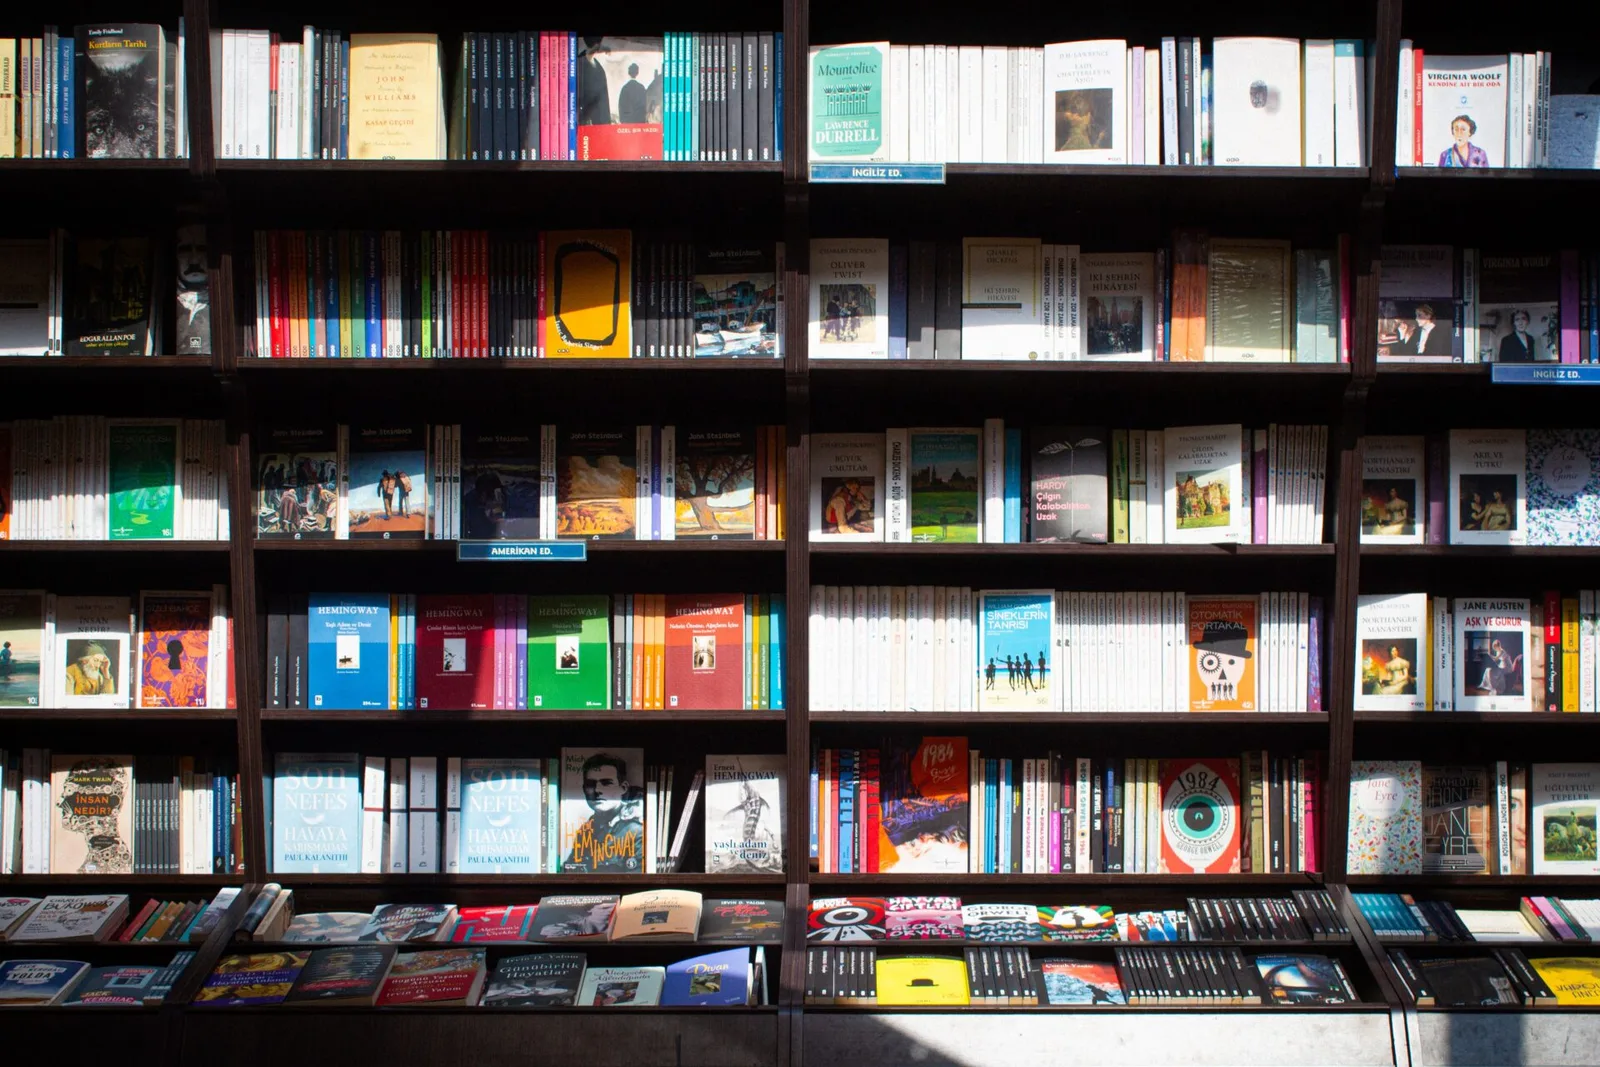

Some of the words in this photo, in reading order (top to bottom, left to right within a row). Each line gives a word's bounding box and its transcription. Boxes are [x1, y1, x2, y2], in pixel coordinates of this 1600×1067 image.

[122, 39, 147, 49] Tarihi
[817, 62, 878, 77] Mountolive
[1428, 73, 1467, 81] VIRGINIA
[1469, 72, 1502, 80] WOOLF
[824, 119, 870, 130] LAWRENCE
[815, 129, 879, 144] DURRELL
[851, 167, 886, 179] İNGİLİZ
[887, 168, 903, 179] ED.
[829, 260, 866, 270] OLIVER
[832, 270, 864, 280] TWIST
[120, 333, 136, 341] POE
[1533, 369, 1565, 379] İNGİLİZ
[1567, 370, 1581, 379] ED.
[360, 427, 378, 436] John
[379, 427, 413, 436] Steinbeck
[569, 431, 587, 441] John
[587, 431, 623, 441] Steinbeck
[688, 431, 705, 441] John
[706, 431, 741, 441] Steinbeck
[1493, 451, 1504, 459] VE
[892, 462, 901, 481] DICKENS
[1036, 481, 1067, 490] HARDY
[1036, 491, 1061, 503] Çılgın
[1036, 512, 1057, 521] Uzak
[491, 546, 538, 556] AMERİKAN
[539, 547, 553, 555] ED.
[318, 605, 379, 615] HEMINGWAY
[1462, 601, 1488, 611] JANE
[1489, 601, 1525, 611] AUSTEN
[425, 608, 484, 618] HEMINGWAY
[538, 606, 598, 617] HEMINGWAY
[674, 606, 735, 617] HEMINGWAY
[986, 609, 1048, 621] SİNEKLERİN
[1190, 608, 1243, 620] OTOMATİK
[987, 619, 1029, 630] TANRISI
[1362, 615, 1418, 625] NORTHANGER
[1464, 616, 1482, 628] AŞK
[1482, 617, 1495, 626] VE
[1495, 616, 1523, 627] GURUR
[1191, 620, 1247, 631] PORTAKAL
[1367, 624, 1412, 634] MANASTIRI
[921, 742, 954, 769] 1984
[713, 763, 736, 771] Ernest
[713, 771, 776, 780] HEMINGWAY
[1176, 771, 1220, 794] 1984
[75, 793, 109, 804] İNSAN
[283, 792, 347, 810] NEFES
[1374, 790, 1398, 804] Eyre
[1550, 792, 1590, 801] TEPELER
[469, 795, 530, 813] NEFES
[74, 805, 113, 816] NEDİR?
[283, 826, 348, 842] HAVAYA
[468, 828, 529, 844] HAVAYA
[739, 839, 767, 849] adam
[1200, 839, 1224, 857] ORWELL
[1425, 836, 1483, 855] EYRE
[284, 853, 303, 862] PAUL
[467, 855, 486, 864] PAUL
[739, 849, 768, 861] deniz
[967, 910, 1032, 918] ORWELL
[891, 923, 958, 931] GEORGE
[890, 929, 960, 938] ORWELL
[1050, 932, 1114, 941] BURMA
[499, 962, 580, 975] Günübirlik
[684, 962, 730, 975] Divan
[1045, 962, 1071, 970] Çocuk
[10, 971, 52, 980] YOLDA
[505, 969, 570, 980] Hayatlar
